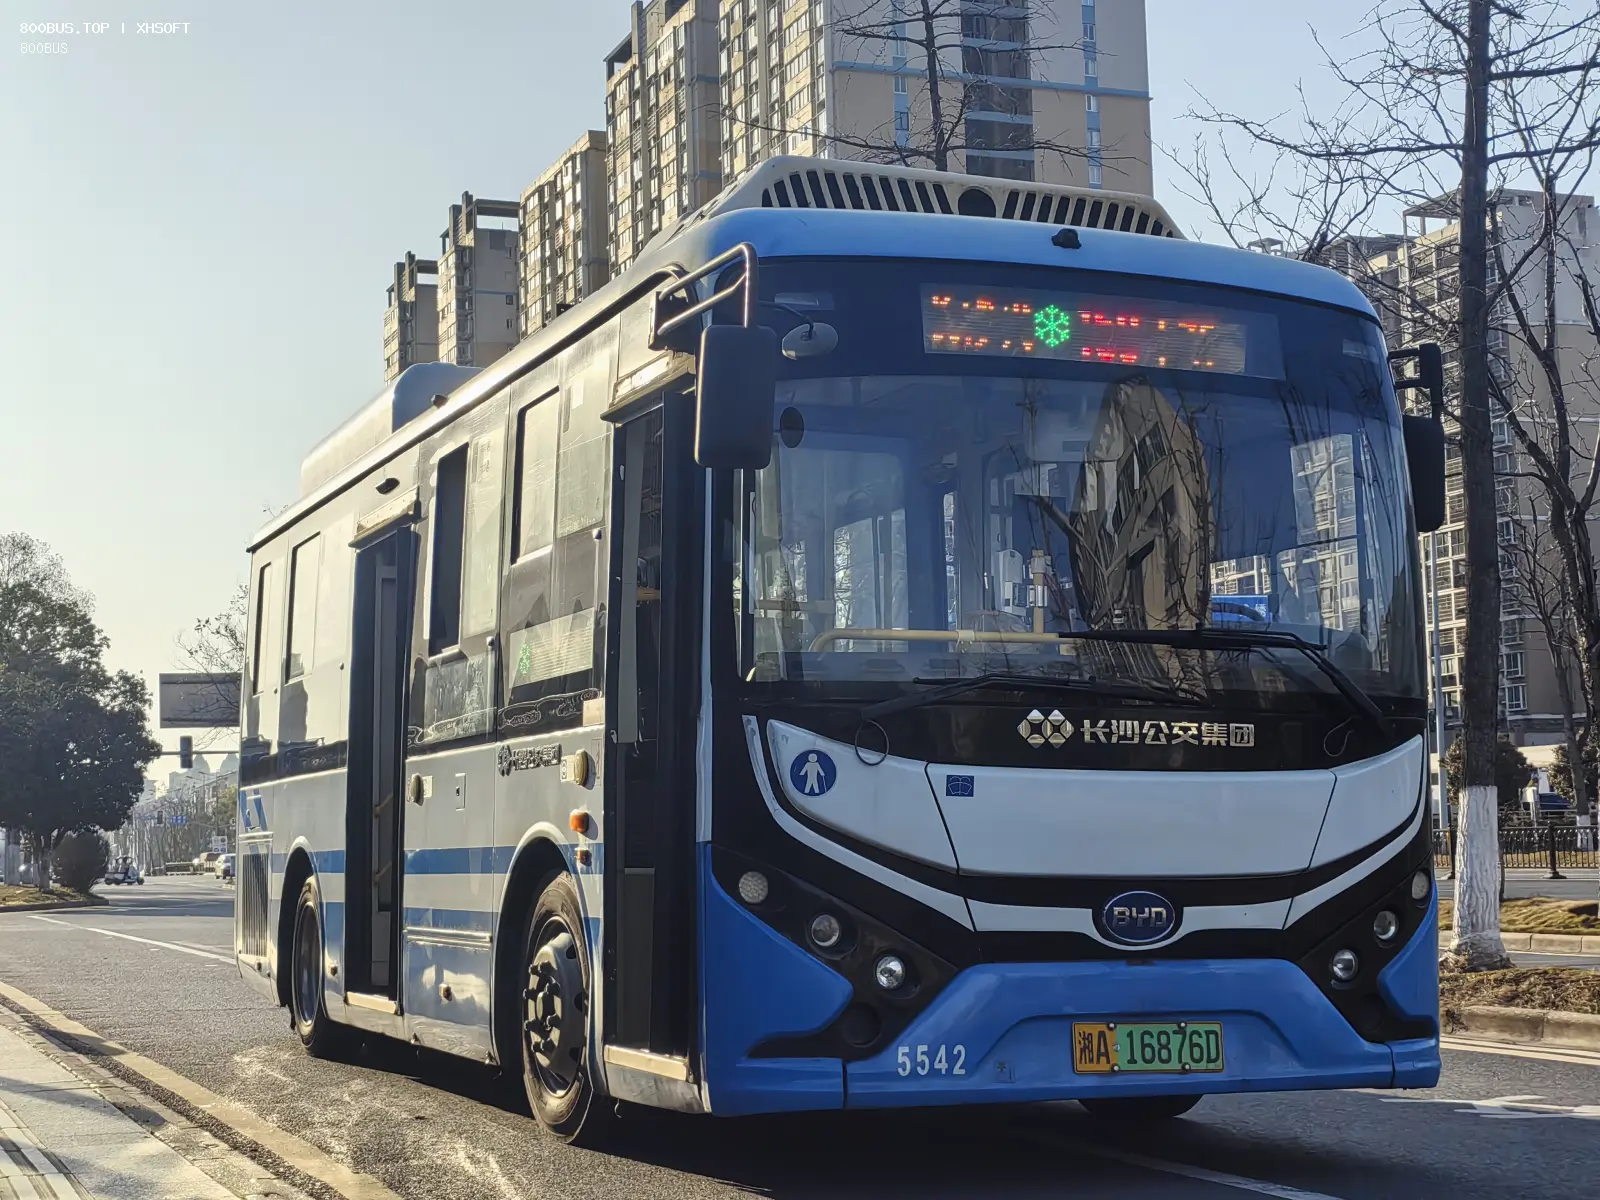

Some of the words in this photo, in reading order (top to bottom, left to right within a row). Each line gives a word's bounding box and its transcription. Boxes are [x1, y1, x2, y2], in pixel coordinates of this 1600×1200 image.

[1080, 718, 1256, 748] 长沙公交集团
[1112, 906, 1167, 928] BYD
[897, 1044, 966, 1077] 5542
